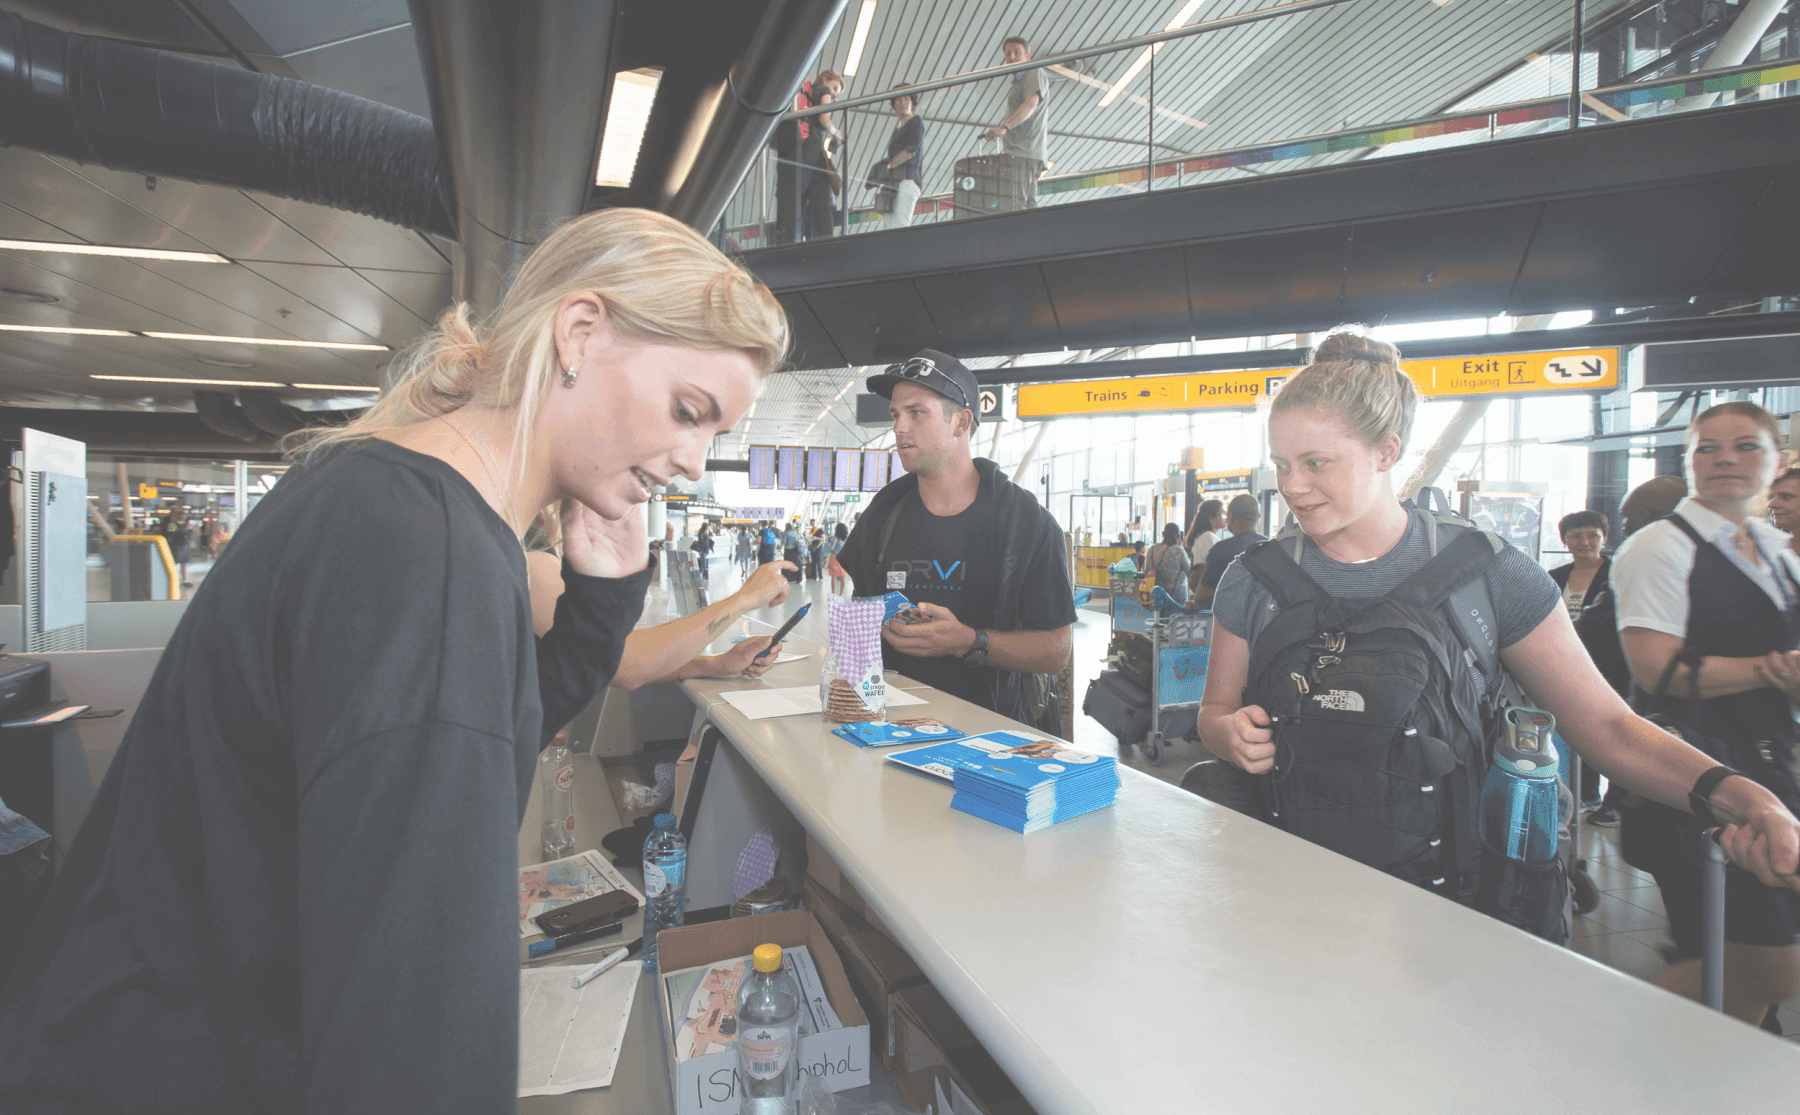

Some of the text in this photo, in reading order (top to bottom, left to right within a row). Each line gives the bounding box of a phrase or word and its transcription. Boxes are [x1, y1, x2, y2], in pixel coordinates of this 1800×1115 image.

[1463, 360, 1499, 374] Exit
[1451, 378, 1500, 389] Uitgang
[1085, 390, 1127, 402] Trains
[1199, 382, 1259, 396] Parking
[1312, 694, 1348, 703] NORTH
[1320, 701, 1347, 710] FACE
